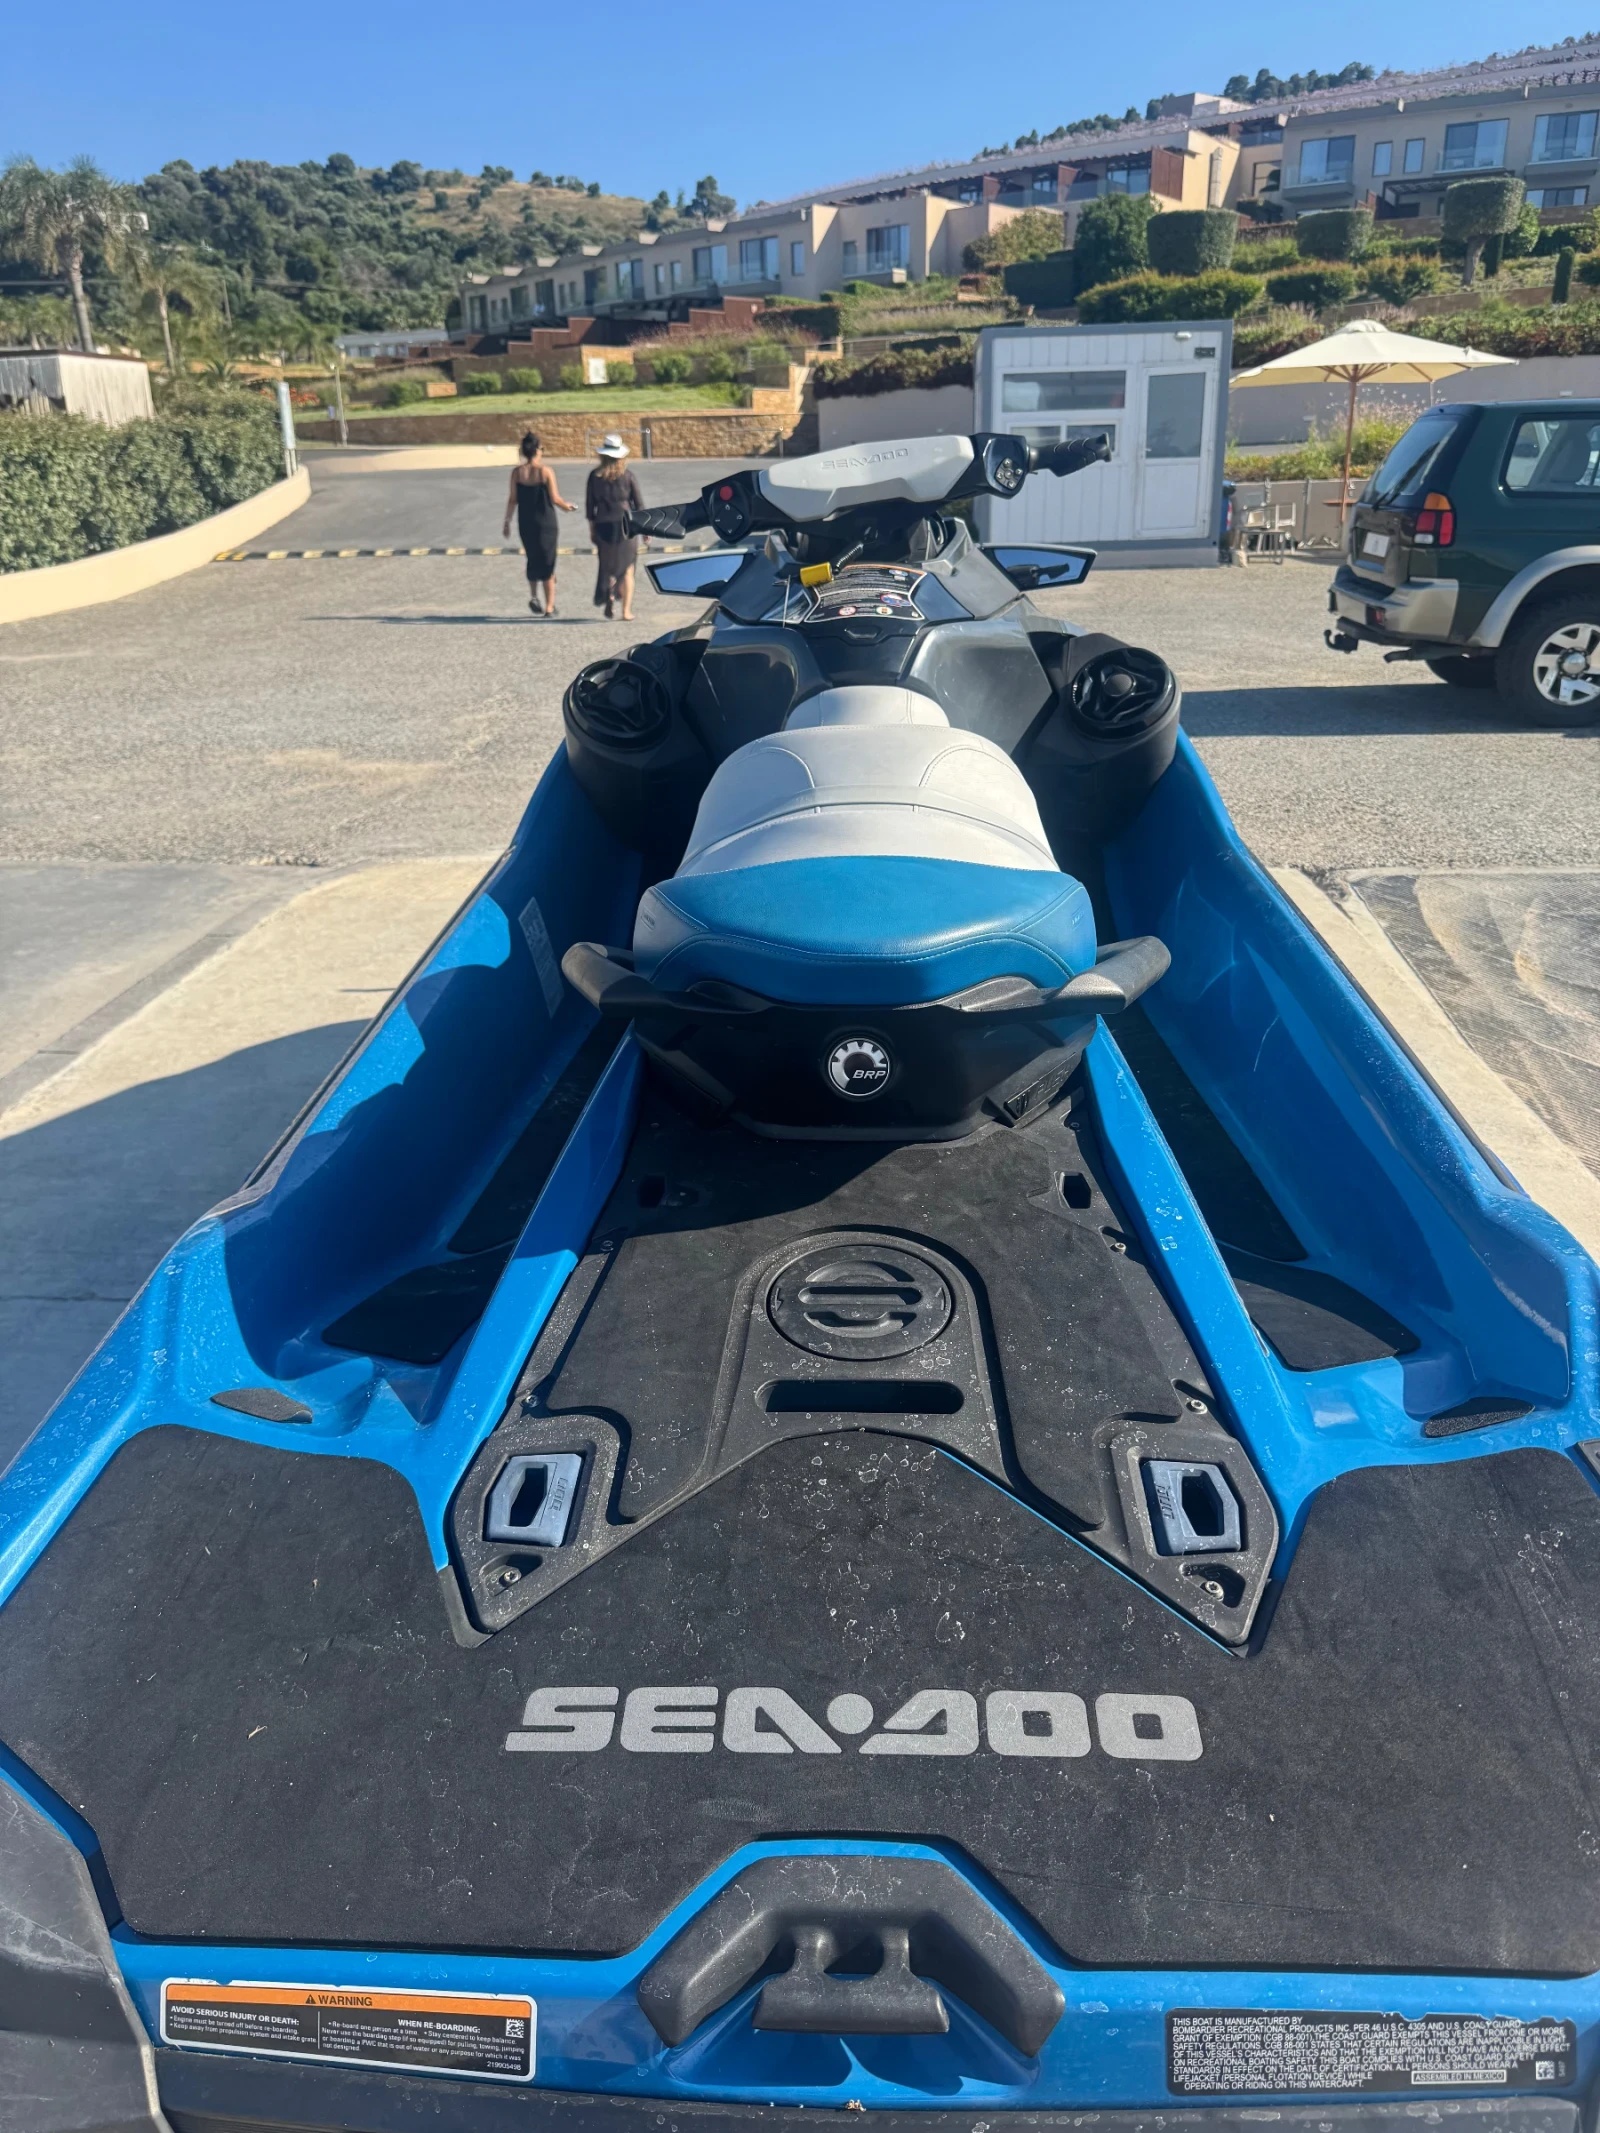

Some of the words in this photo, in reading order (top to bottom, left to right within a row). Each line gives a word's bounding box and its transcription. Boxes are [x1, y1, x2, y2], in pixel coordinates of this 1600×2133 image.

[852, 1069, 886, 1080] BRP
[318, 1995, 372, 2007] WARNING
[171, 2005, 195, 2014] AVOID
[196, 2008, 229, 2018] SERIOUS
[230, 2011, 257, 2021] INJURY
[271, 2016, 300, 2026] DEATH:
[1172, 2017, 1191, 2026] THIS
[1192, 2017, 1214, 2026] BOAT
[1215, 2017, 1223, 2025] IS
[1224, 2016, 1290, 2025] MANUFACTURED
[1291, 2016, 1303, 2025] BY
[397, 2018, 422, 2028] WHEN
[423, 2022, 481, 2034] RE-BOARDING:
[1172, 2026, 1225, 2034] BOMBARDIER
[1227, 2025, 1287, 2034] RECREATIONAL
[1289, 2024, 1334, 2033] PRODUCTS
[1353, 2024, 1370, 2032] PER
[1427, 2022, 1444, 2030] AND
[1172, 2034, 1200, 2042] GRANT
[1202, 2034, 1213, 2042] OF
[1215, 2034, 1261, 2042] EXEMPTION
[1263, 2033, 1283, 2042] (CGB
[1332, 2032, 1359, 2040] COAST
[1361, 2031, 1390, 2040] GUARD
[1392, 2031, 1430, 2039] EXEMPTS
[1431, 2030, 1450, 2038] THIS
[1451, 2029, 1482, 2038] VESSEL
[1484, 2028, 1508, 2037] FROM
[1509, 2028, 1526, 2037] ONE
[1528, 2027, 1540, 2036] OR
[1173, 2042, 1204, 2050] SAFETY
[1264, 2041, 1282, 2049] CGB
[1311, 2040, 1340, 2049] STATES
[1342, 2040, 1362, 2048] THAT
[1364, 2040, 1398, 2048] CERTAIN
[1400, 2039, 1456, 2047] REGULATIONS
[1458, 2038, 1474, 2046] ARE
[1476, 2037, 1532, 2045] INAPPLICABLE
[1533, 2036, 1541, 2044] IN
[1186, 2050, 1204, 2058] THIS
[1244, 2049, 1319, 2058] CHARACTERISTICS
[1320, 2048, 1338, 2056] AND
[1339, 2048, 1359, 2056] THAT
[1361, 2048, 1377, 2056] THE
[1379, 2047, 1426, 2055] EXEMPTION
[1427, 2047, 1446, 2055] WILL
[1447, 2046, 1464, 2054] NOT
[1466, 2045, 1487, 2054] HAVE
[1488, 2045, 1500, 2053] AN
[1501, 2044, 1539, 2053] ADVERSE
[1540, 2043, 1571, 2052] EFFECT
[1187, 2058, 1247, 2066] RECREATIONAL
[1248, 2057, 1284, 2066] BOATING
[1340, 2056, 1361, 2064] BOAT
[1362, 2055, 1403, 2063] COMPLIES
[1405, 2055, 1425, 2063] WITH
[1444, 2054, 1472, 2062] COAST
[1473, 2053, 1503, 2061] GUARD
[1504, 2052, 1535, 2061] SAFETY
[1173, 2066, 1221, 2074] STANDARDS
[1222, 2066, 1231, 2074] IN
[1232, 2065, 1263, 2074] EFFECT
[1264, 2065, 1277, 2073] ON
[1279, 2065, 1295, 2073] THE
[1296, 2065, 1317, 2073] DATE
[1319, 2064, 1330, 2072] OF
[1395, 2063, 1410, 2071] ALL
[1411, 2062, 1450, 2070] PERSONS
[1452, 2061, 1486, 2070] SHOULD
[1487, 2061, 1511, 2069] WEAR
[1511, 2061, 1518, 2069] A
[1173, 2074, 1219, 2082] LIFEJACKET
[1268, 2072, 1312, 2081] FLOTATION
[1347, 2071, 1373, 2080] WHILE
[1415, 2073, 1461, 2081] ASSEMBLED
[1464, 2072, 1471, 2080] IN
[1473, 2072, 1503, 2080] MEXICO
[1184, 2082, 1230, 2090] OPERATING
[1231, 2081, 1243, 2089] OR
[1245, 2081, 1273, 2089] RIDING
[1274, 2081, 1287, 2089] ON
[1289, 2080, 1307, 2089] THIS
